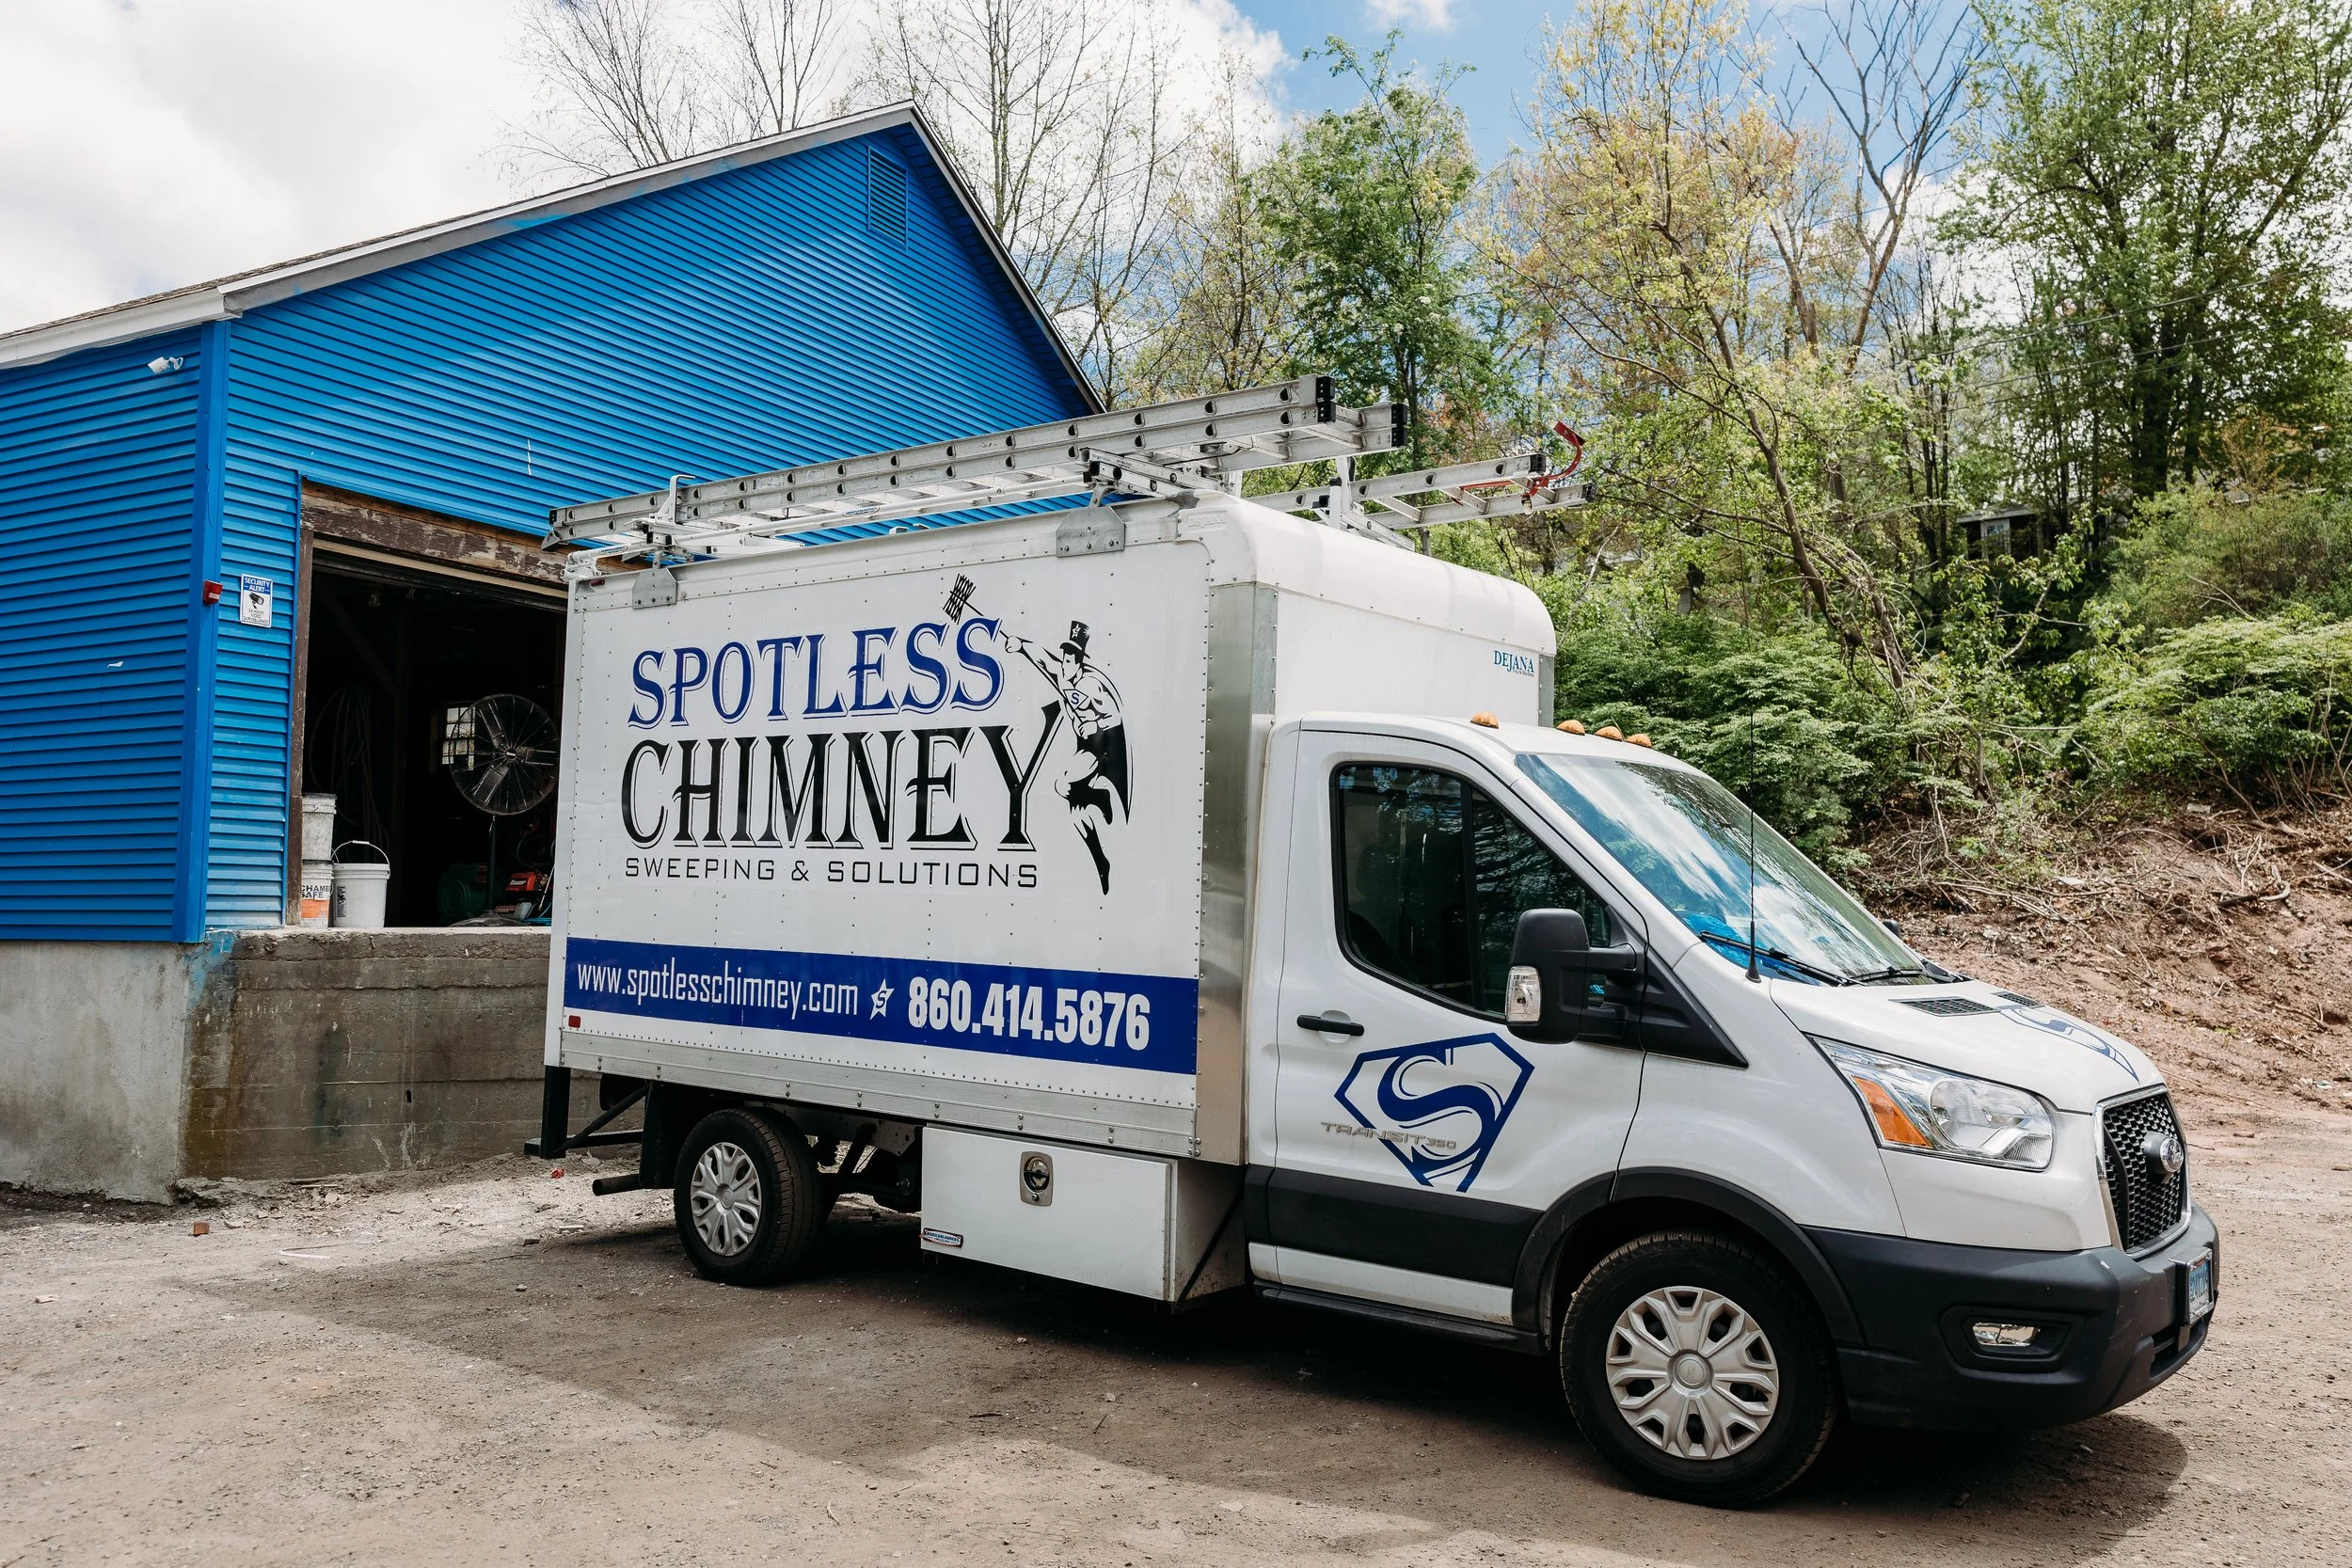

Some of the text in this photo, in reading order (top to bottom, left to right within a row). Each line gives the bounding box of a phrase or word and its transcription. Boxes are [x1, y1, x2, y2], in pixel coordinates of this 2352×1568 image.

[245, 577, 271, 587] SECURITY
[248, 584, 265, 593] ALERT
[628, 617, 1006, 730] SPOTLESS
[1493, 650, 1534, 673] DEJANA
[620, 701, 1066, 852] CHIMNEY
[625, 857, 1038, 888] SWEEPING & SOLUTIONS
[577, 957, 858, 1021] www.spotlesschimney.com
[908, 976, 1151, 1051] 860.414.5876
